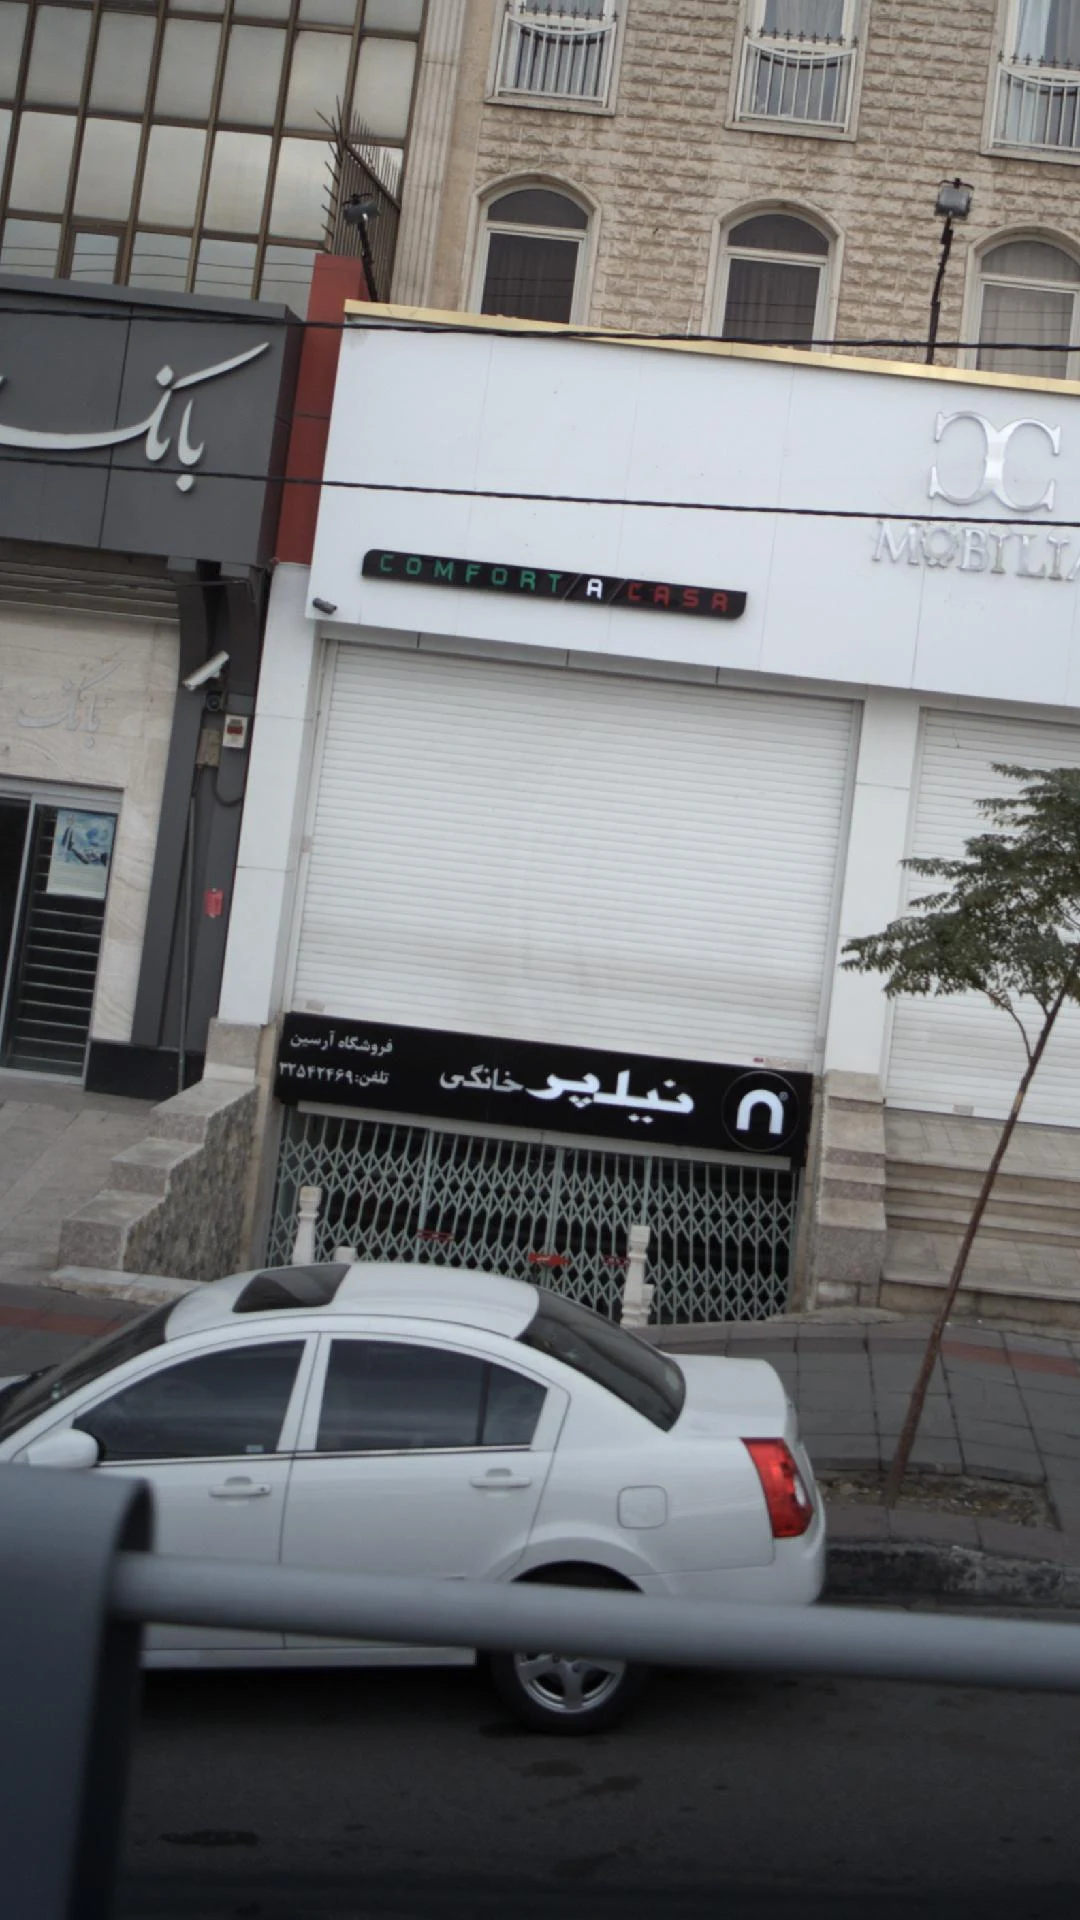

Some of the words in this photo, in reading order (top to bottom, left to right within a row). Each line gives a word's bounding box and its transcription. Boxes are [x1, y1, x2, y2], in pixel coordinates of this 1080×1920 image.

[380, 554, 562, 593] COMFORT
[586, 577, 603, 600] A
[628, 583, 729, 613] CASA
[338, 1035, 393, 1057] فروشگاه
[439, 1064, 525, 1093] خانگی
